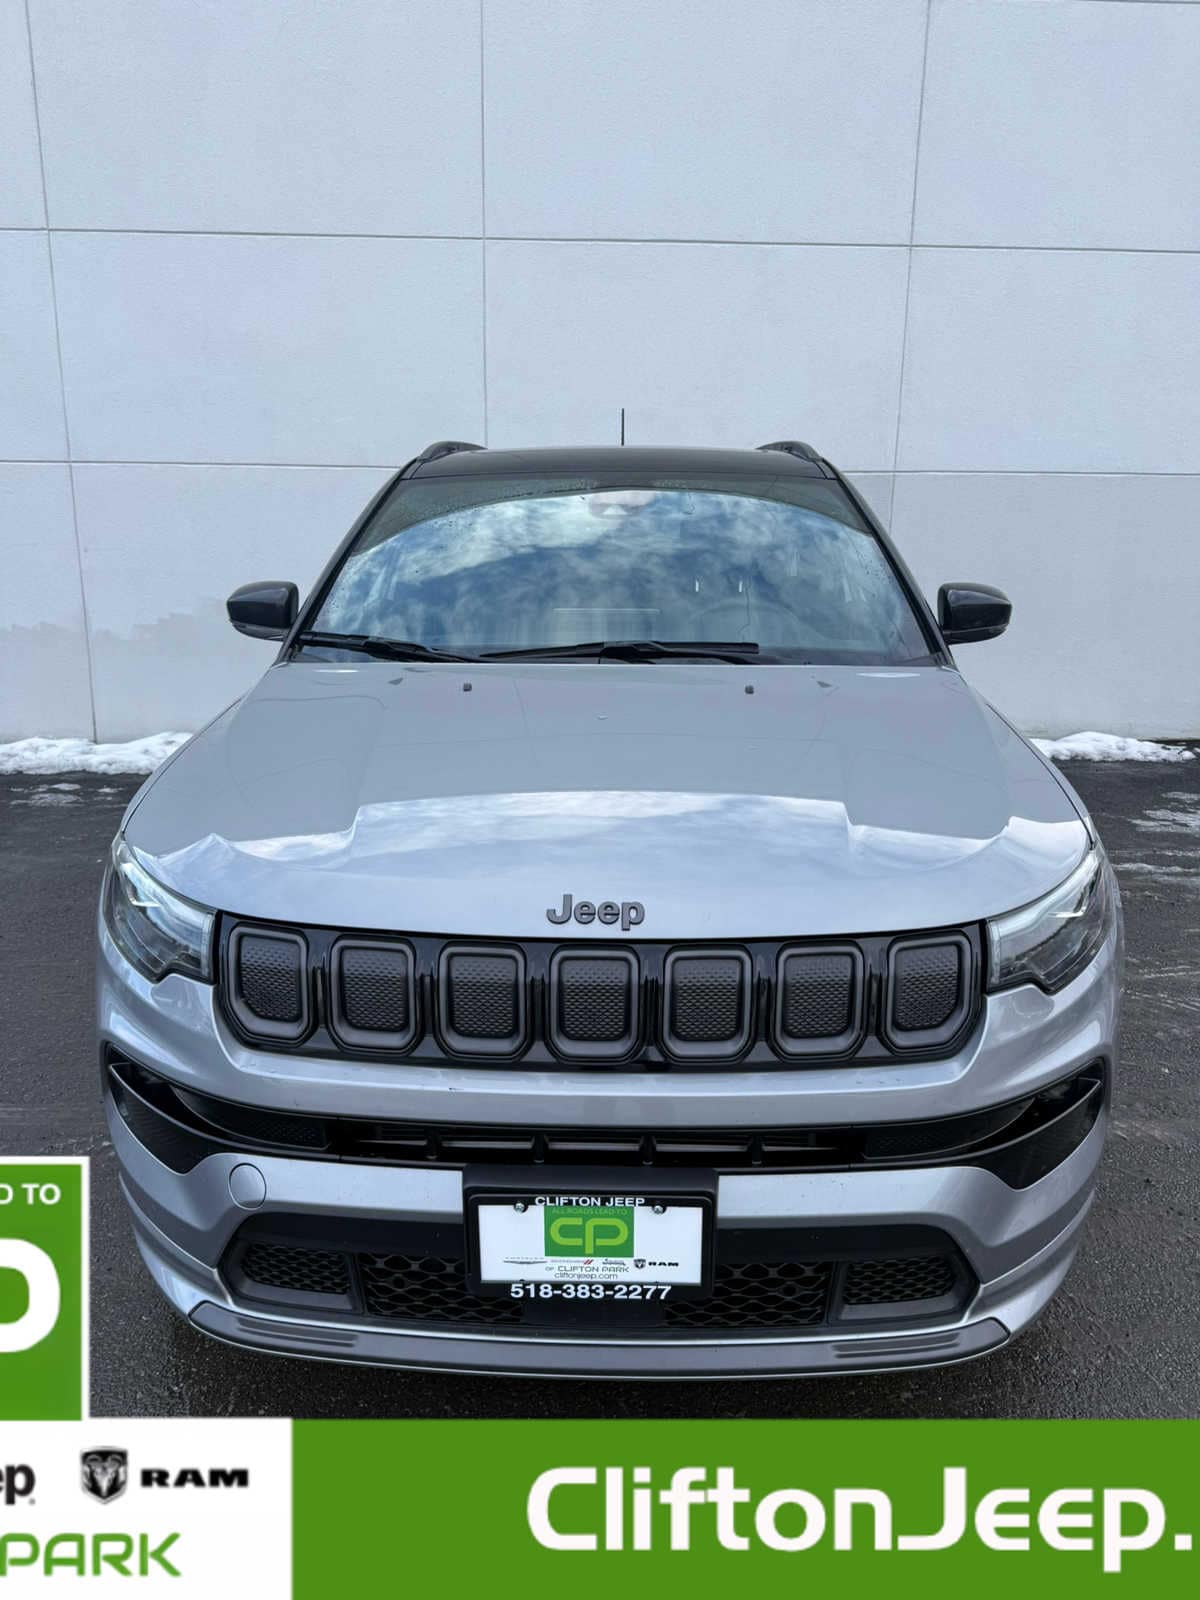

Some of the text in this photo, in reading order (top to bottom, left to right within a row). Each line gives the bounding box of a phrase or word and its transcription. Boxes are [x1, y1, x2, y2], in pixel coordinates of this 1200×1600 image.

[546, 894, 645, 931] Jeep
[535, 1196, 645, 1207] CLIFTON JEEP
[557, 1265, 599, 1273] CLIFTON
[601, 1265, 630, 1273] PARK
[554, 1272, 619, 1280] cliftonjeep.com
[510, 1283, 672, 1300] 518-383-2277
